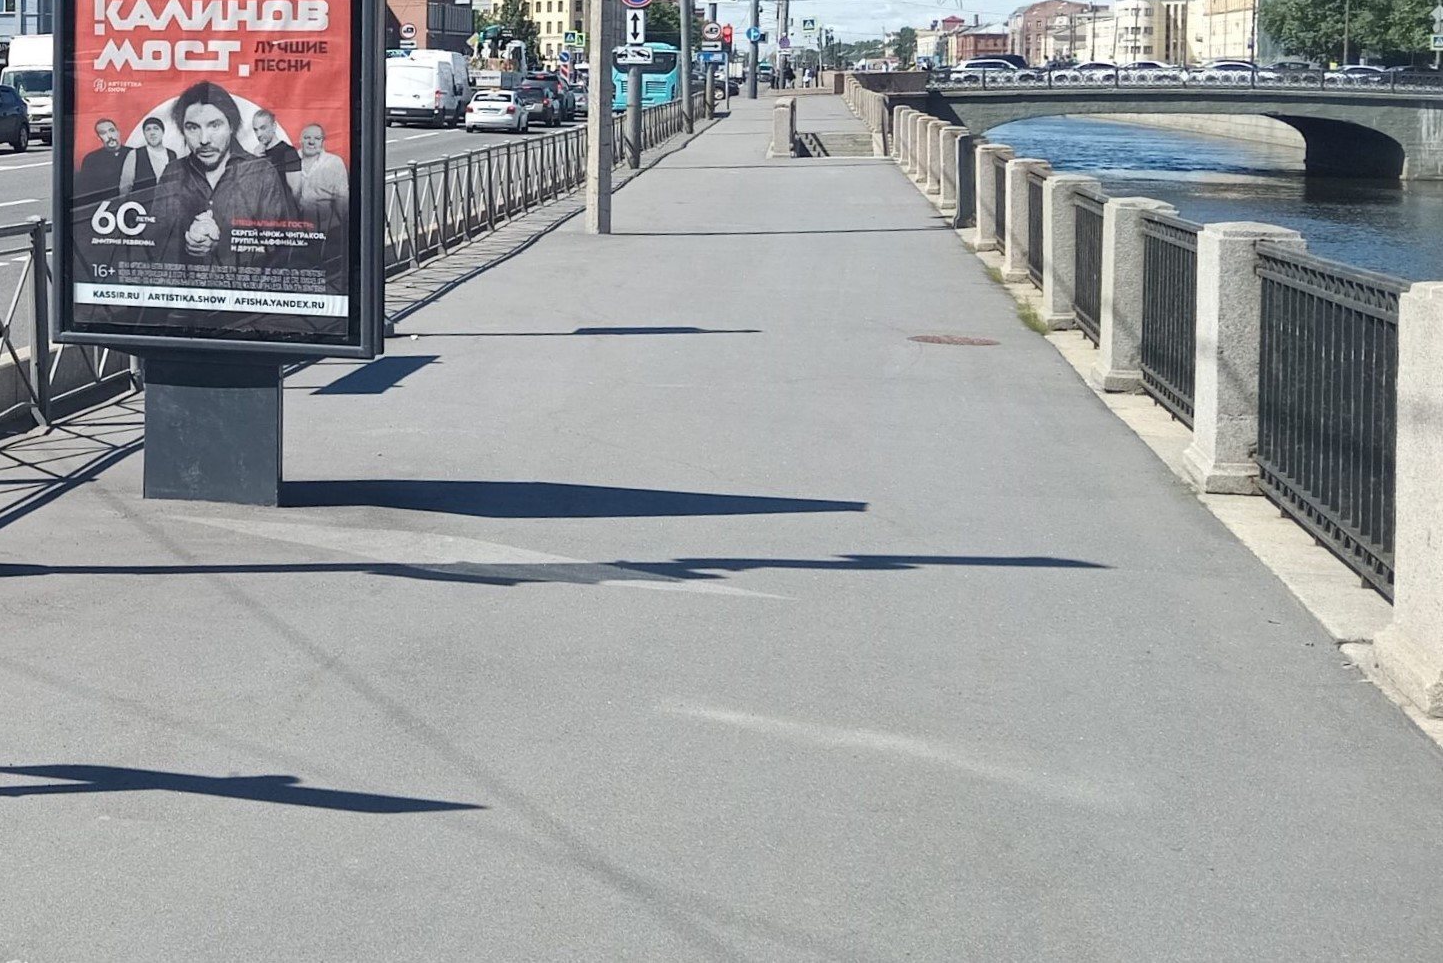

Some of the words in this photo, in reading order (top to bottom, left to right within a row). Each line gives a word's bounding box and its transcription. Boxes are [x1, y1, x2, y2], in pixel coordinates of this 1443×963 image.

[254, 41, 328, 55] ЛУЧШИЕ
[254, 59, 311, 72] ПЕСНИ
[231, 229, 258, 237] СЕРГЕЙ
[231, 237, 259, 245] ГРУППА
[92, 264, 116, 277] 16+
[93, 291, 140, 300] KASSIR.RU
[148, 293, 226, 304] ARTISTIKA.SHOW
[234, 297, 325, 309] AFISHA.YANDEX.RU
